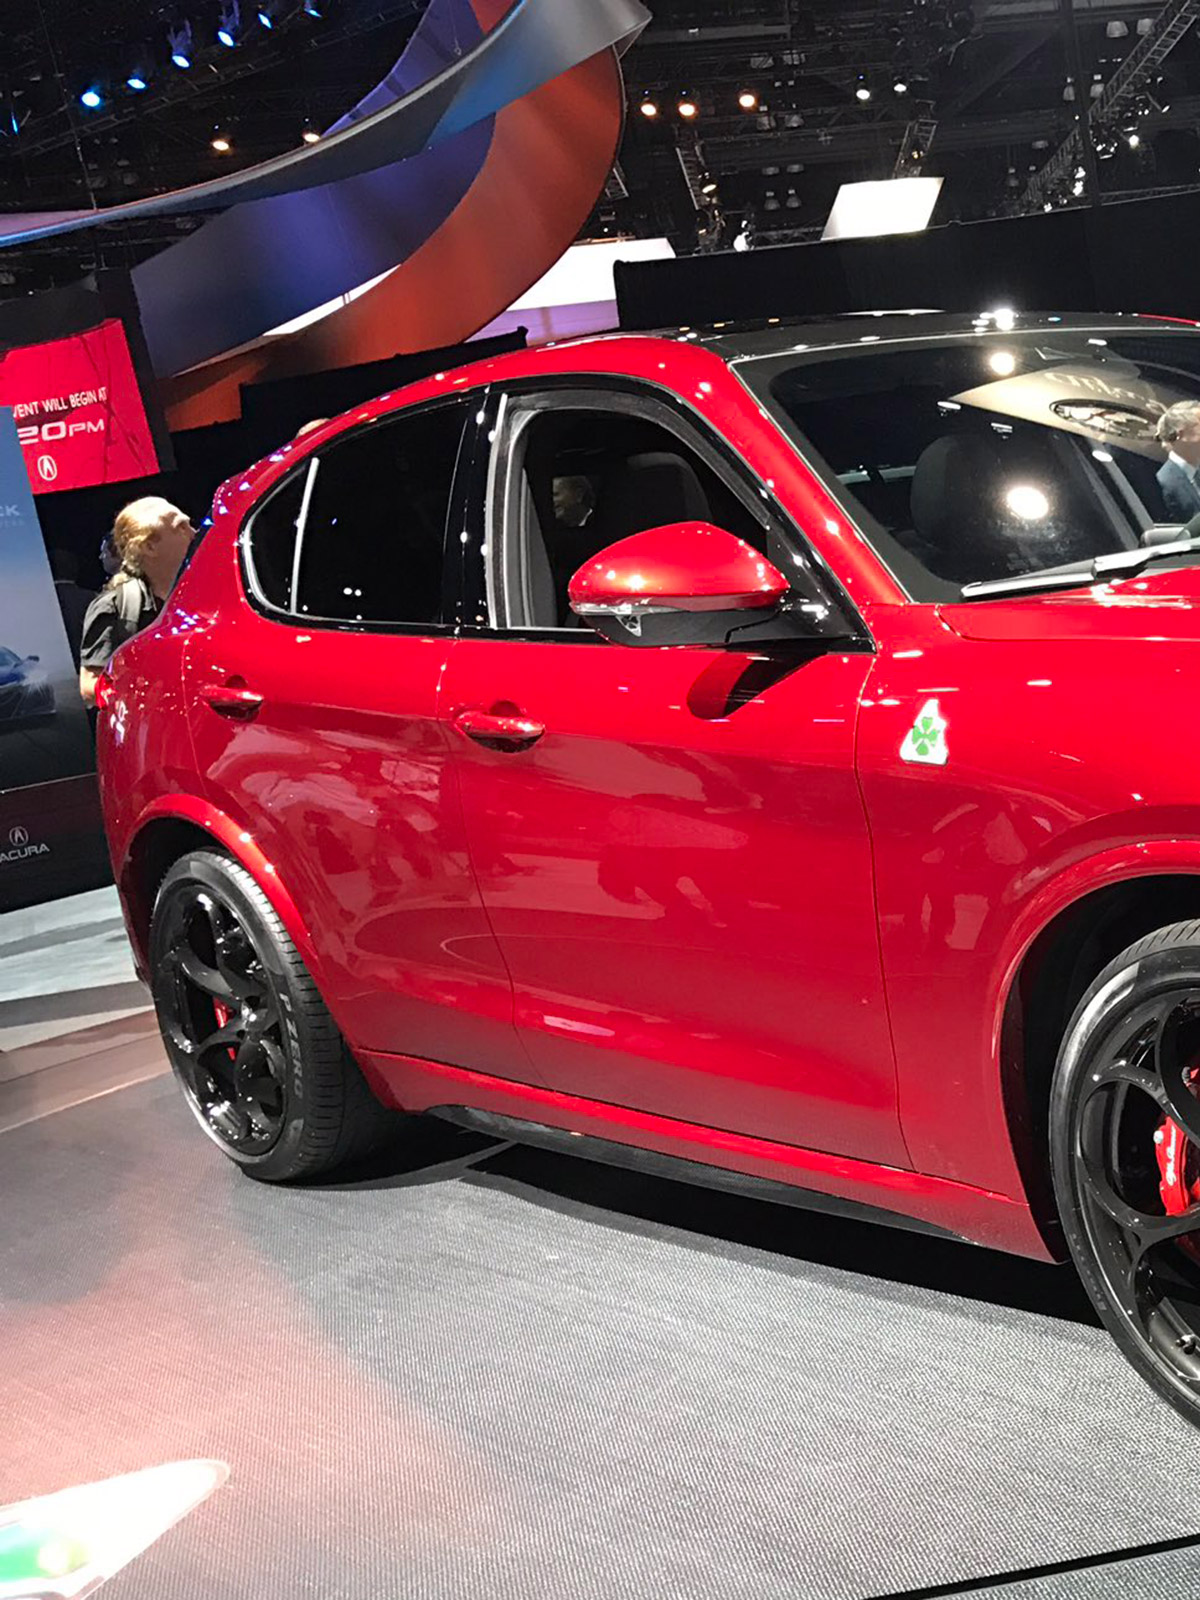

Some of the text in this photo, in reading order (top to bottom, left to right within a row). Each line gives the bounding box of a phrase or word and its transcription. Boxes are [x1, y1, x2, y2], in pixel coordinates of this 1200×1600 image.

[41, 397, 69, 412] WILL
[69, 389, 97, 408] BEGIN
[98, 386, 108, 402] AT
[0, 843, 50, 863] ACURA
